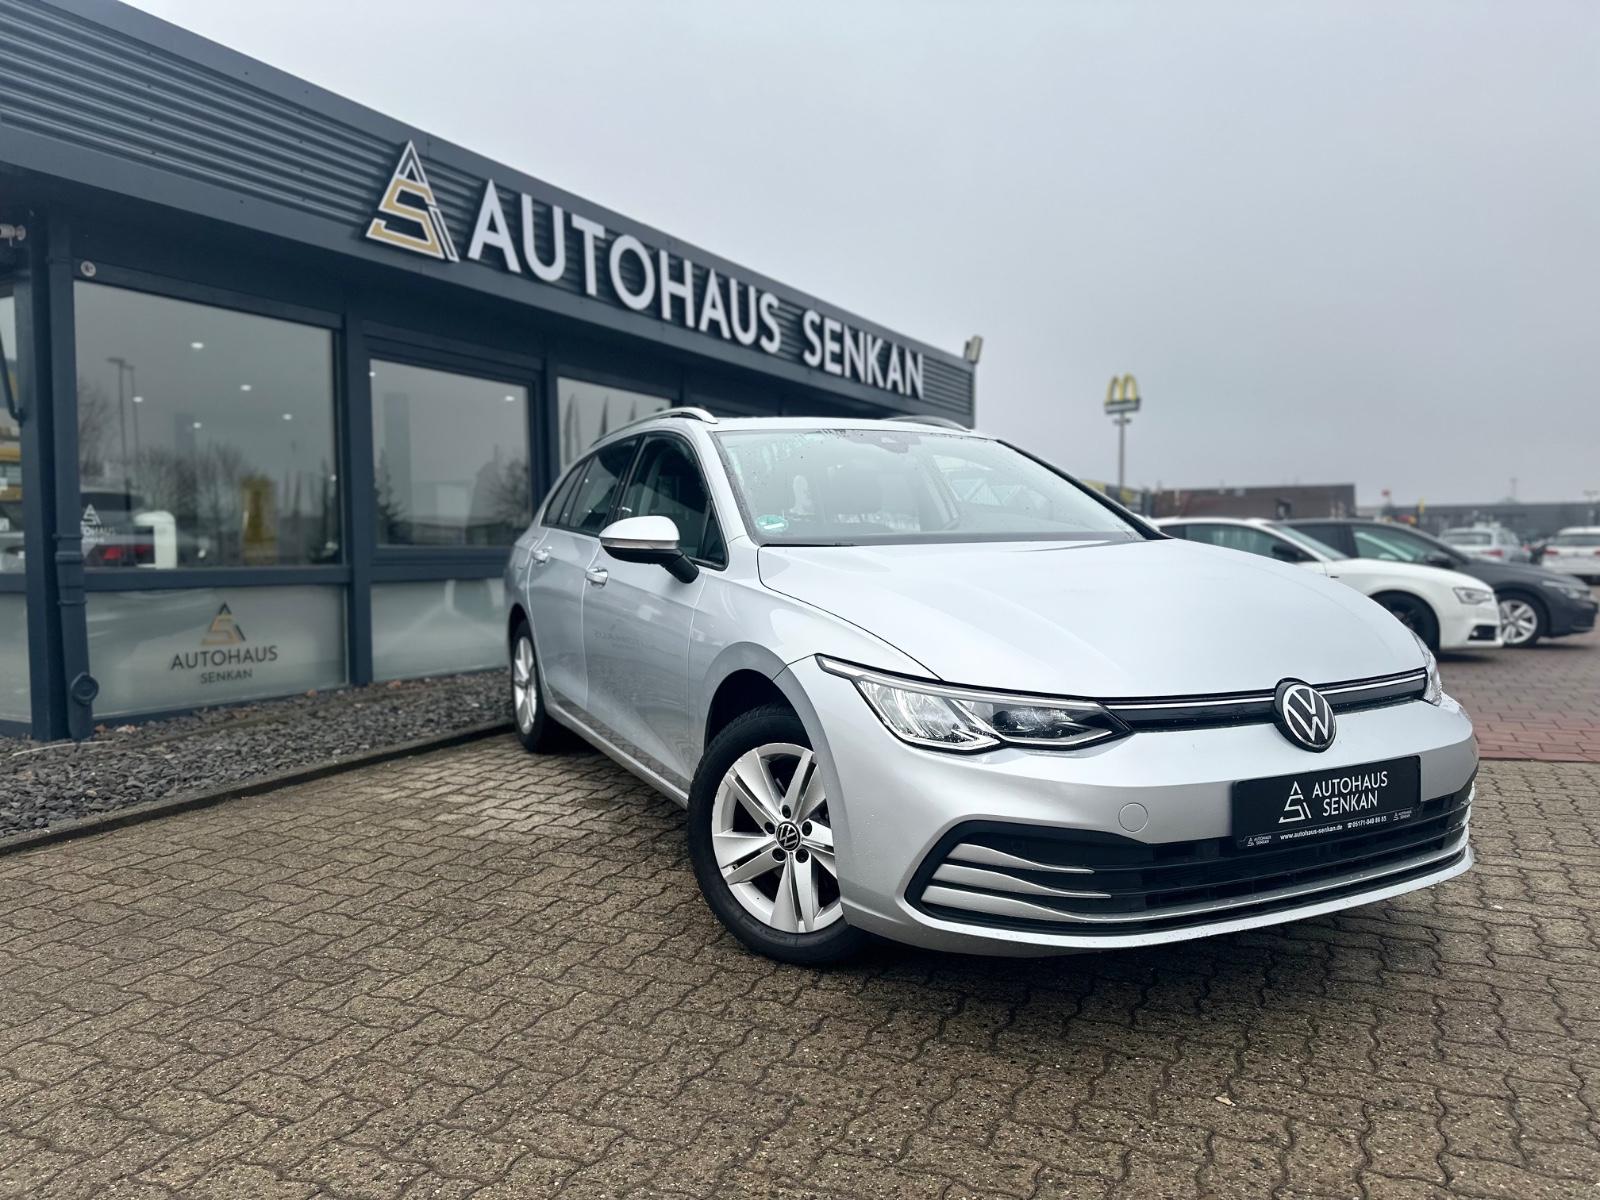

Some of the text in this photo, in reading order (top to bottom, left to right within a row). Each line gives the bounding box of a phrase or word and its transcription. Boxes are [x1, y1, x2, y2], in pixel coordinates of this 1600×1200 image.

[467, 178, 781, 353] AUTOHAUS
[803, 309, 924, 400] SENKAN
[170, 645, 278, 670] AUTOHAUS
[200, 669, 253, 684] SENKAN
[1312, 771, 1388, 799] AUTOHAUS
[1322, 790, 1378, 816] SENKAN
[1280, 825, 1343, 840] www.autohaus-senkan.de
